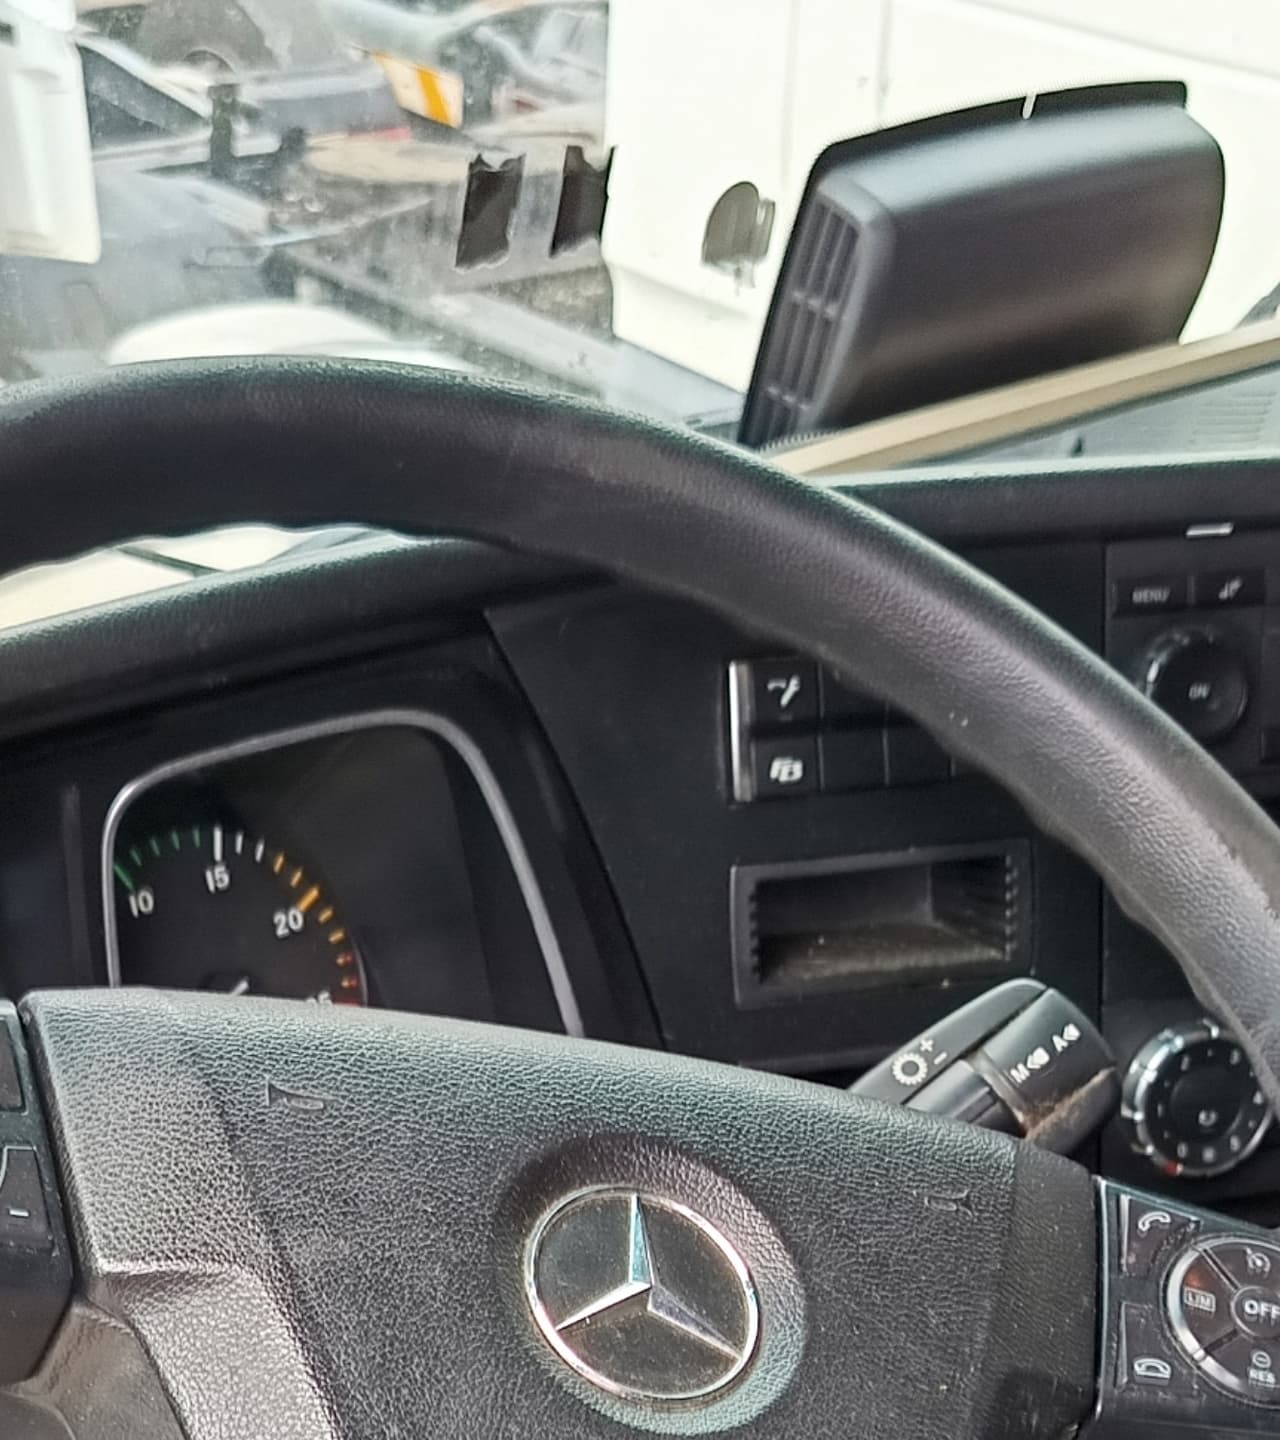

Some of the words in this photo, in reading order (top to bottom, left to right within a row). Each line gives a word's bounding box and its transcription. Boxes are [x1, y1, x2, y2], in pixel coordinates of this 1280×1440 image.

[205, 864, 231, 893] 15
[129, 890, 154, 917] 10
[274, 906, 304, 939] 20
[1052, 1034, 1068, 1053] A
[1010, 1063, 1031, 1084] M
[1187, 1291, 1212, 1309] LIM
[1249, 1368, 1276, 1385] RES
